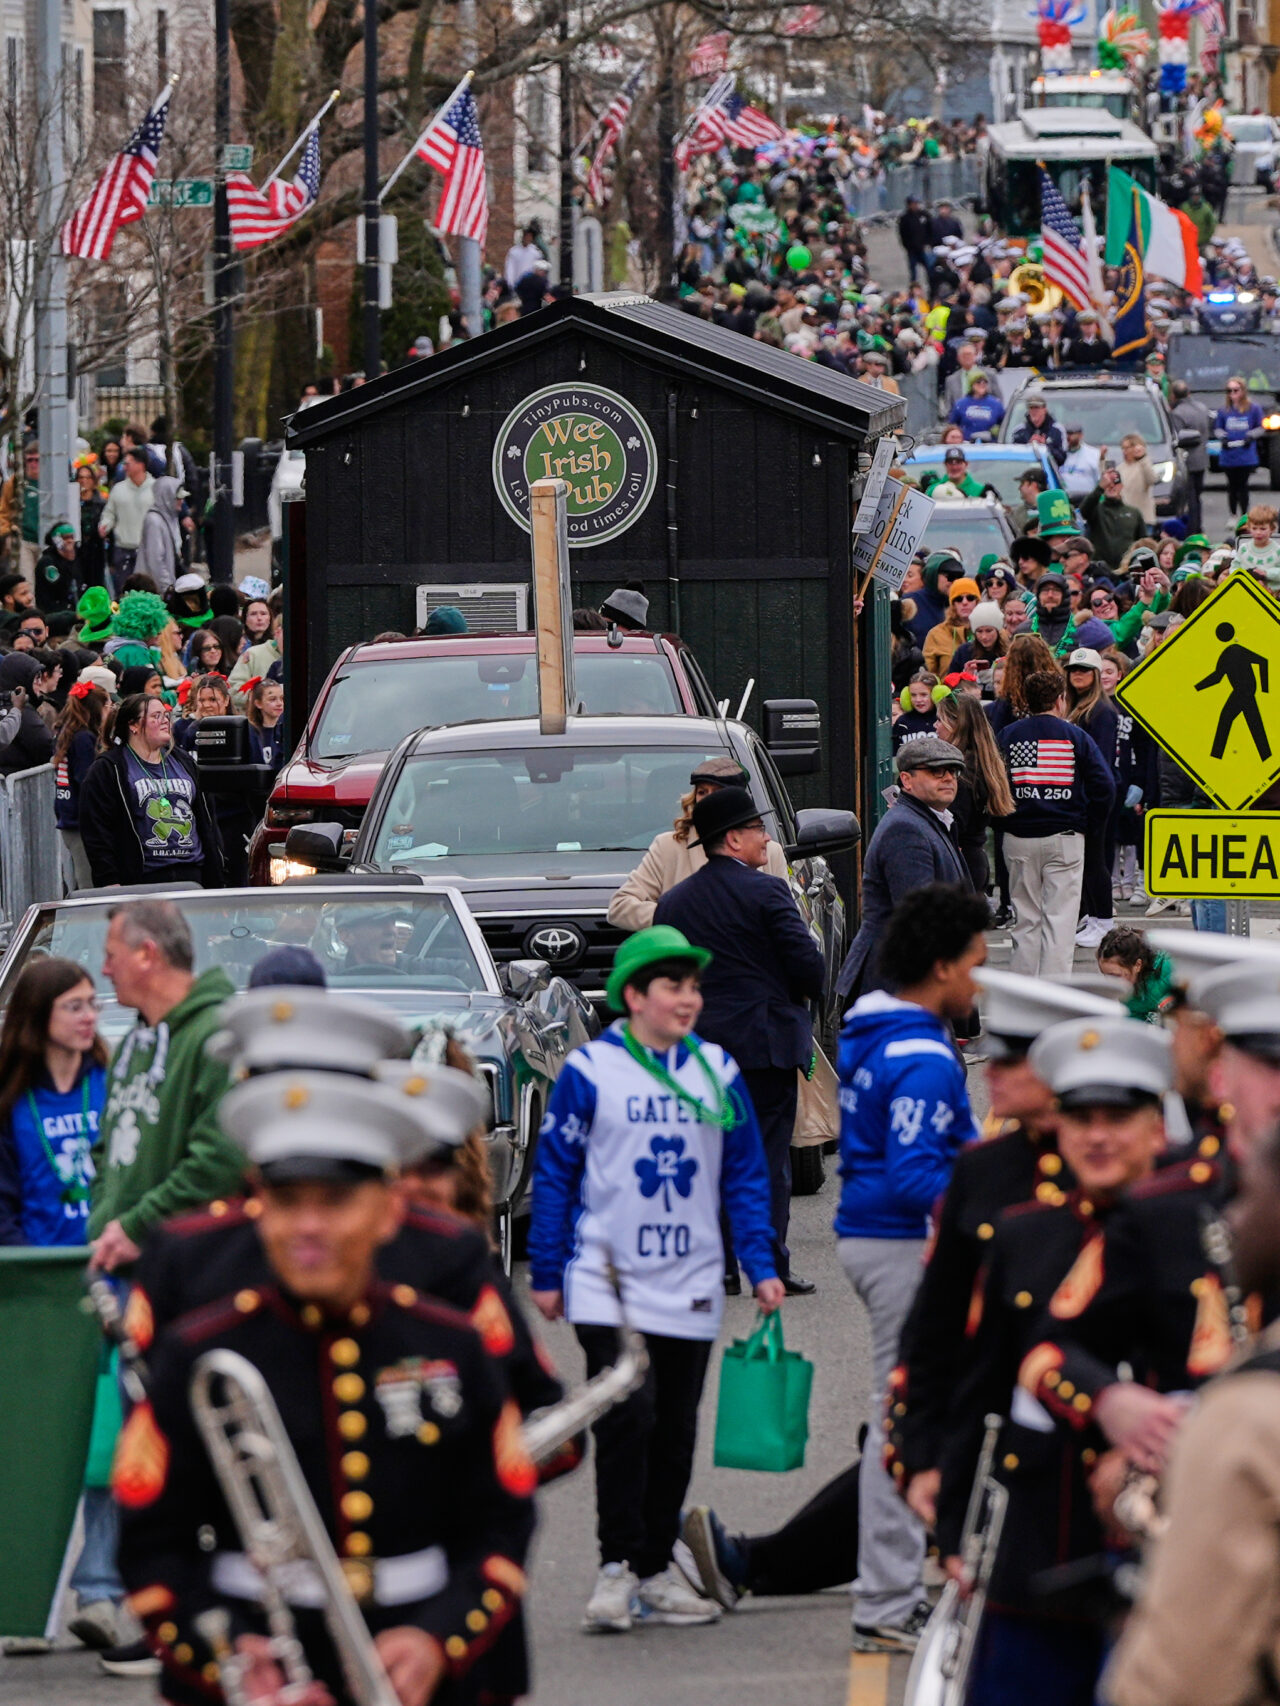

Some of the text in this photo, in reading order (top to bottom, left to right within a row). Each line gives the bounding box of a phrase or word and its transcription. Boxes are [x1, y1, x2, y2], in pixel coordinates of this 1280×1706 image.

[522, 395, 623, 427] TinyPubs.com
[539, 417, 606, 447] Wee
[540, 444, 612, 478] Irish
[510, 480, 528, 504] Let
[593, 501, 630, 529] times
[627, 472, 643, 499] roll
[876, 559, 904, 579] ENATOR
[1015, 786, 1072, 801] USA 250
[638, 1223, 690, 1258] CYO
